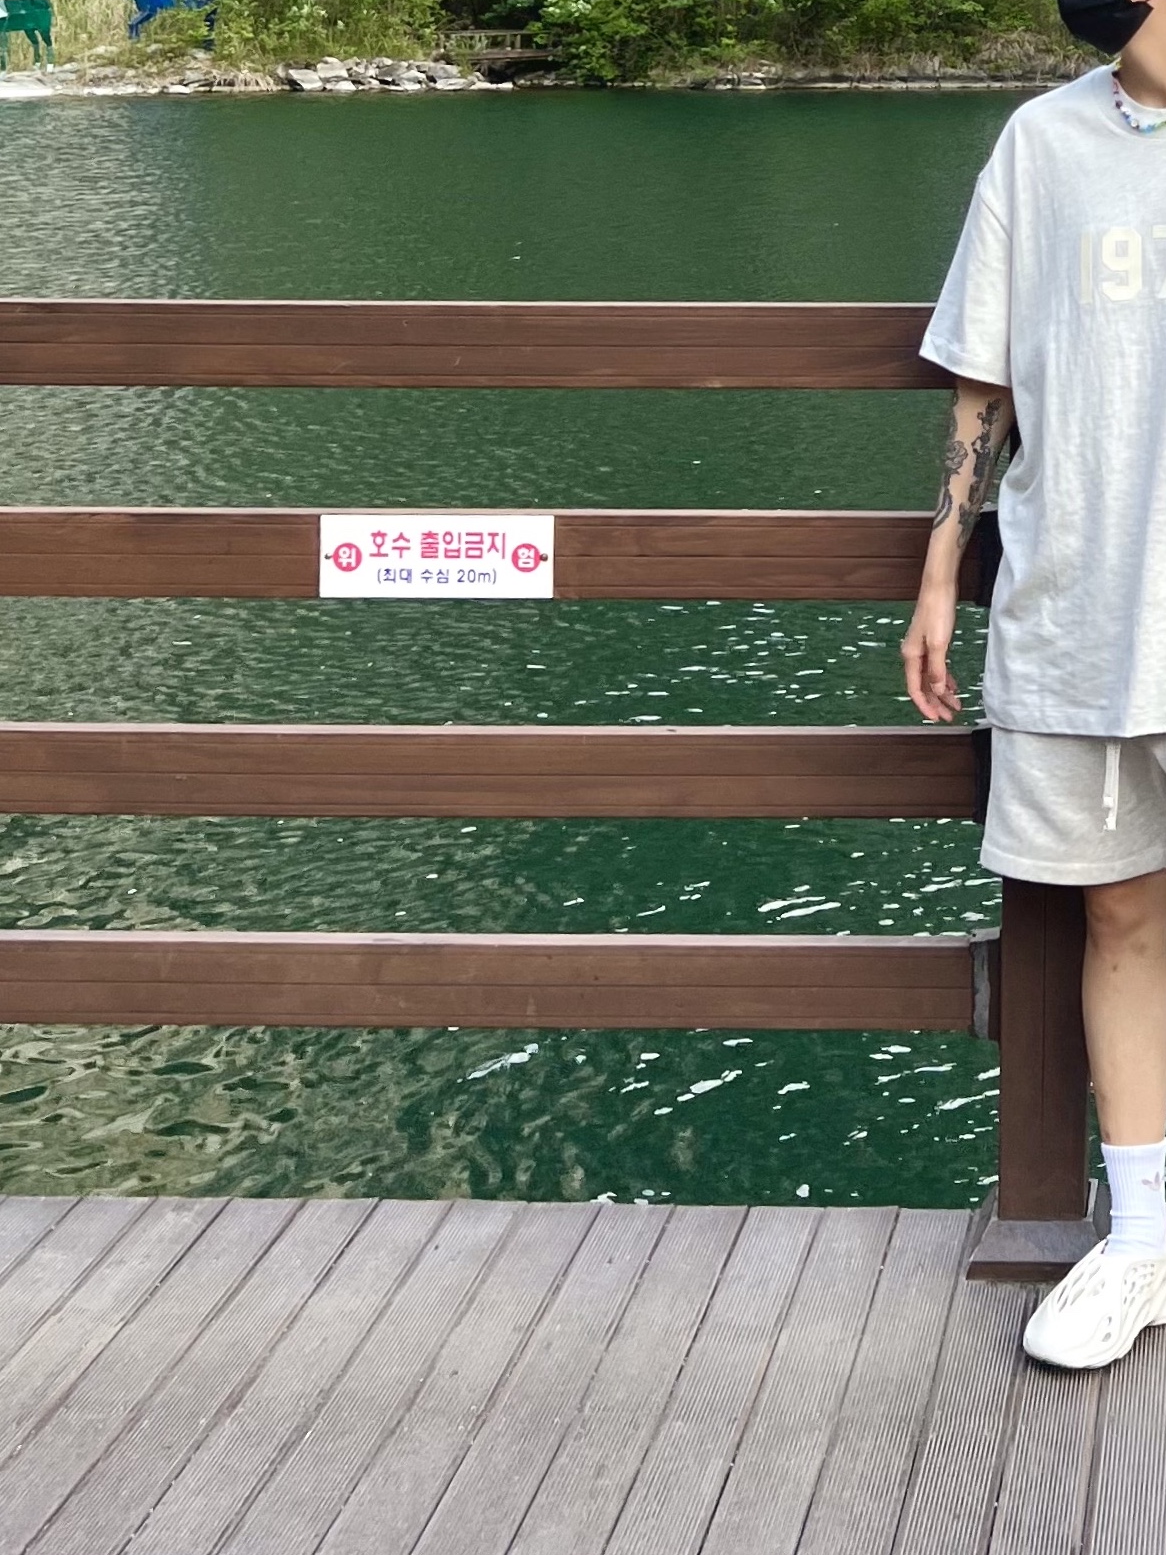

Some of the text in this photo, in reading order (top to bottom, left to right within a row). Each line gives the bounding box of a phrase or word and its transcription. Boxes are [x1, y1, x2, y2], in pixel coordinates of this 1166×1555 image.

[369, 530, 506, 559] 호수 출입금지
[338, 546, 356, 567] 위
[377, 568, 497, 584] (최대 수심 20m)
